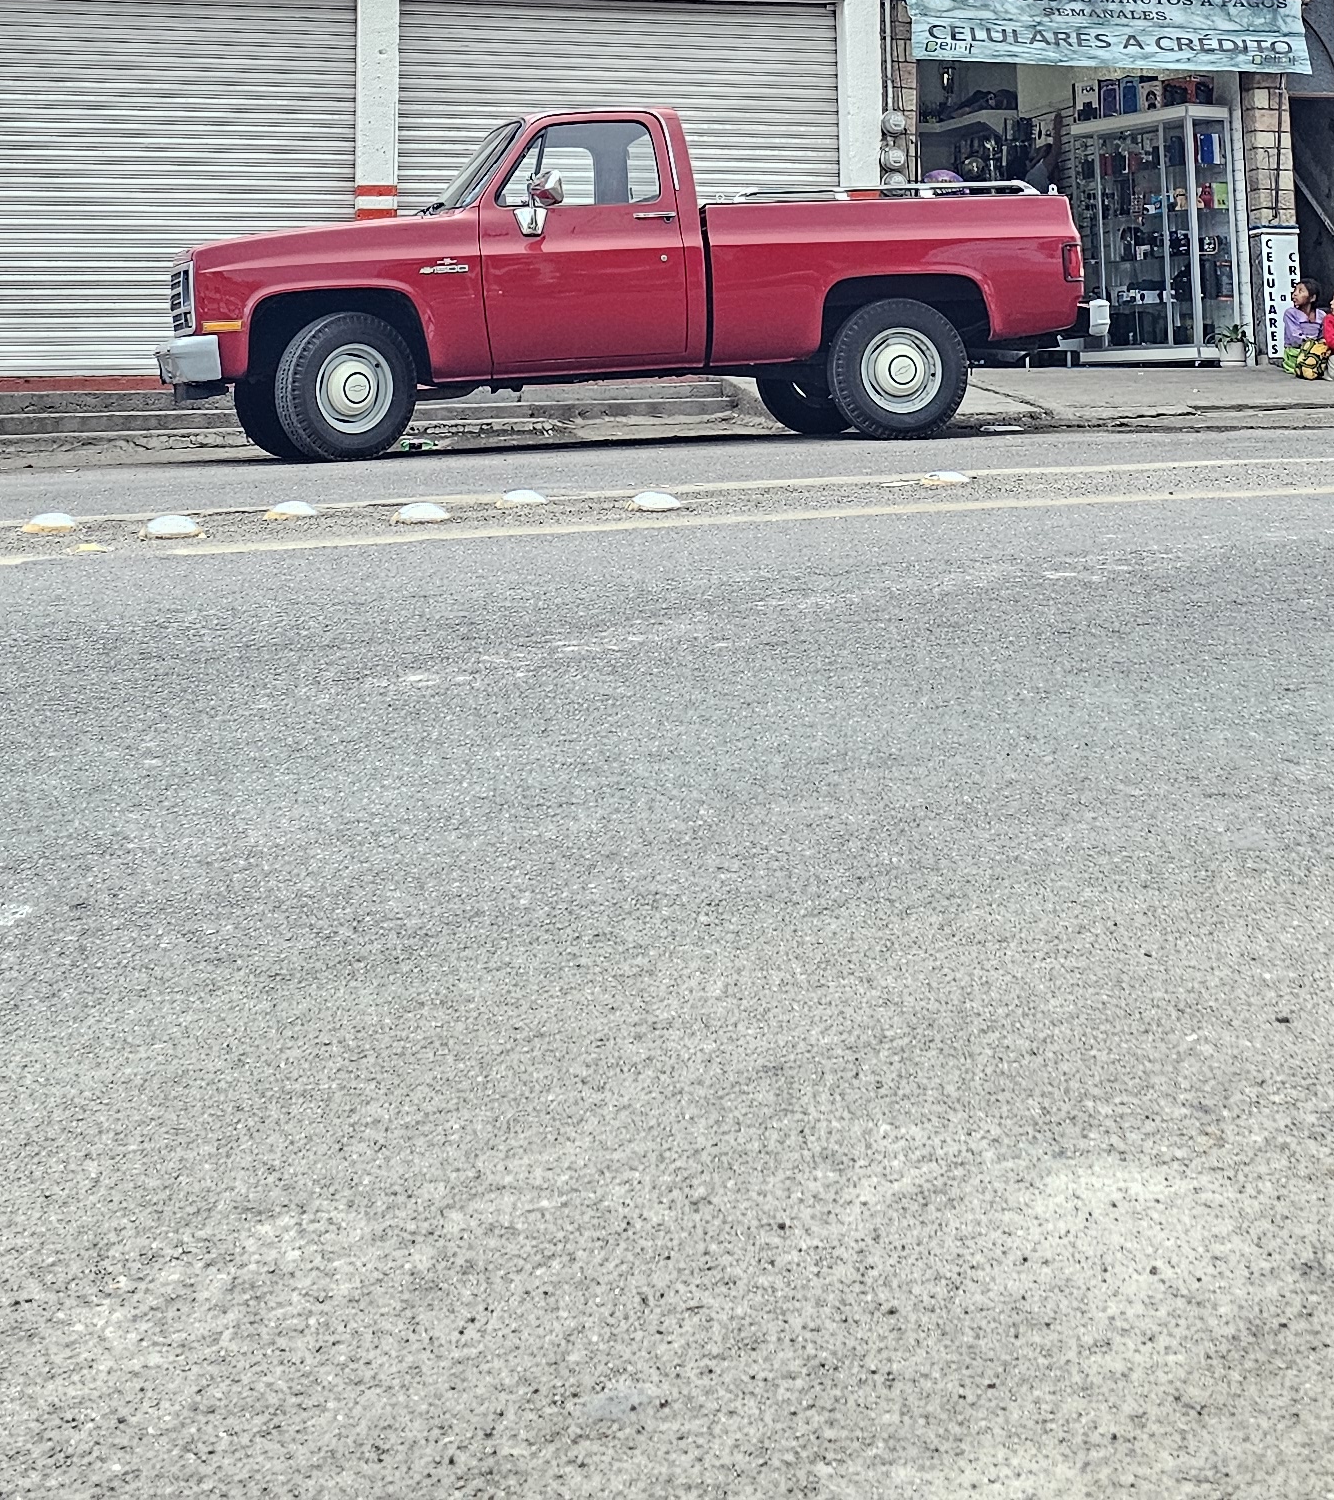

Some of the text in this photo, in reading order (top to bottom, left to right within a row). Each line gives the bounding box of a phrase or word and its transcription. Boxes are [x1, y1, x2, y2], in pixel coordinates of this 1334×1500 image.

[1042, 7, 1173, 21] SEMANALES.
[927, 24, 1293, 55] CELULARES A CRÉDITO
[1265, 238, 1279, 356] CELULARES
[1288, 252, 1298, 302] CRE
